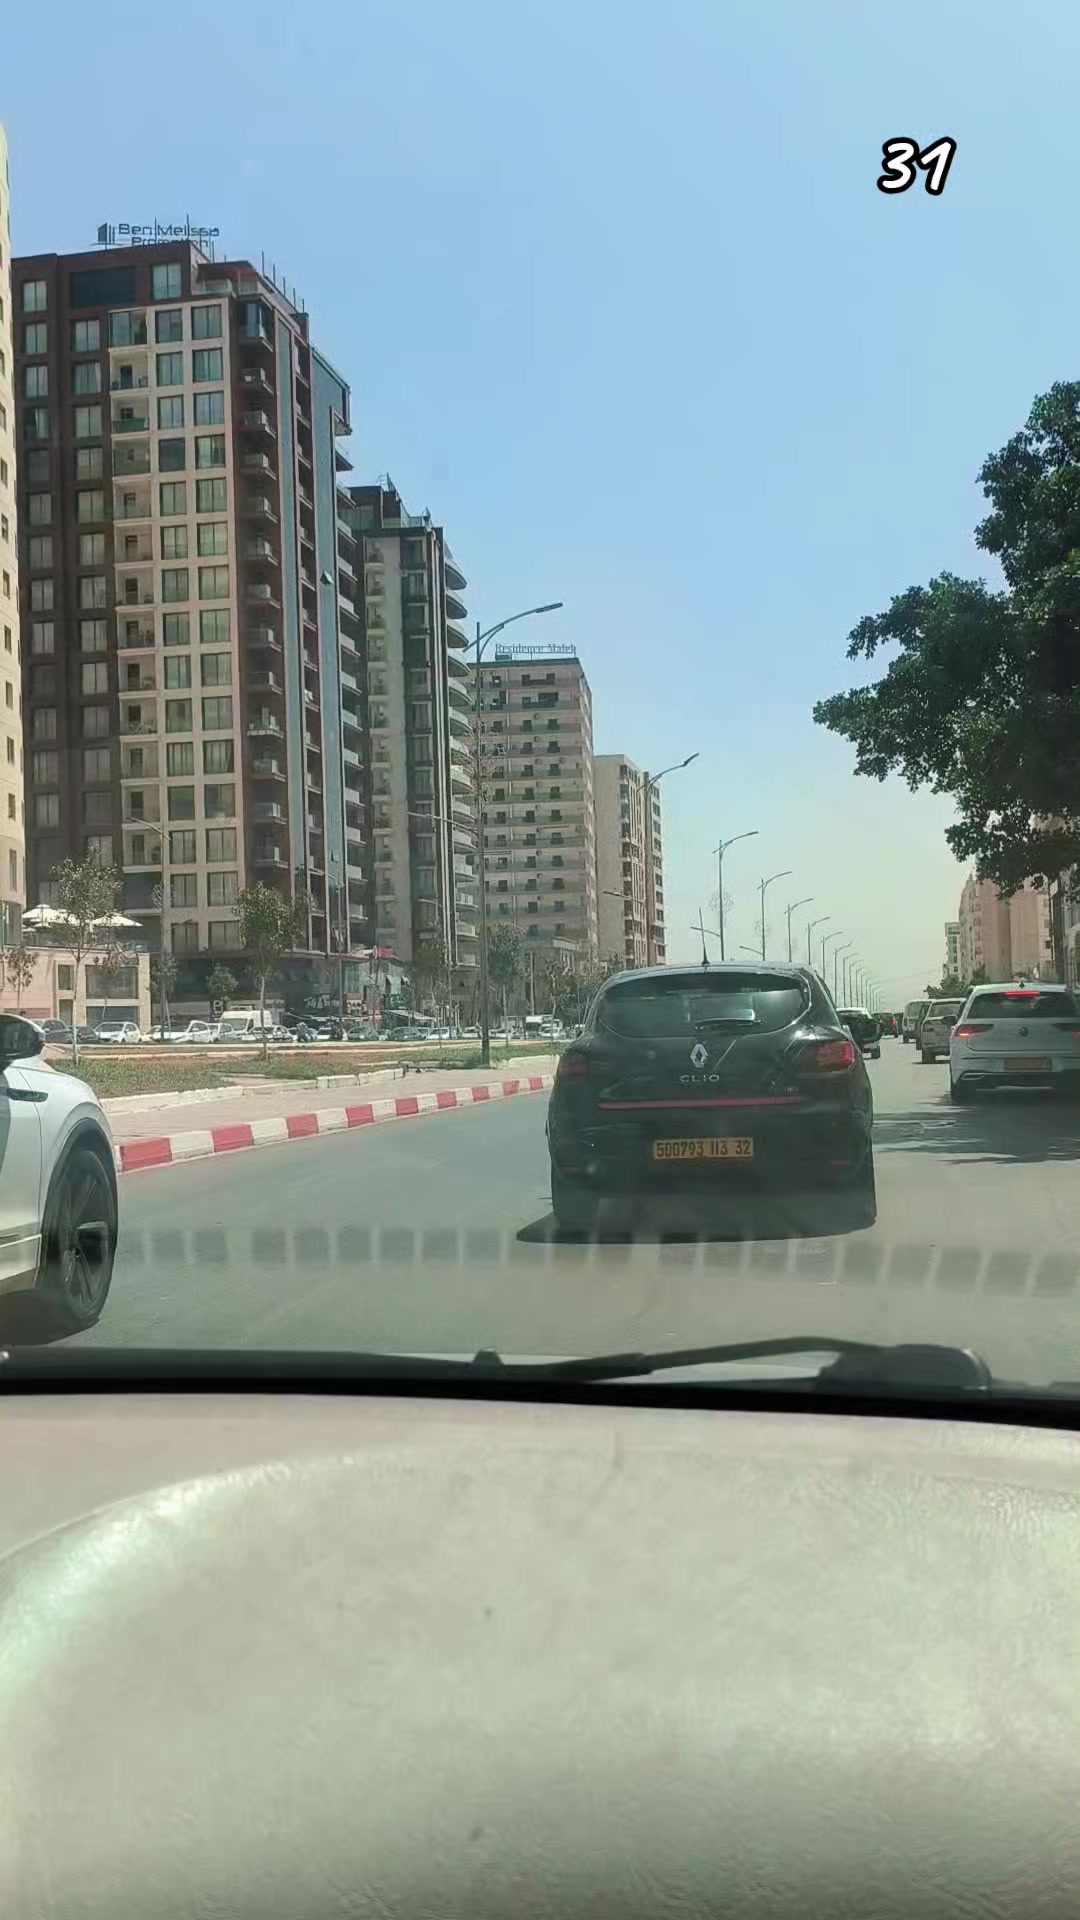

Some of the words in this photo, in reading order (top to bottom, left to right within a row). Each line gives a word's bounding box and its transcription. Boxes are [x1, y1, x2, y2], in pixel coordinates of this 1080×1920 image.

[118, 223, 153, 235] Ben
[680, 1073, 720, 1083] CLIO
[656, 1141, 704, 1158] 500793
[711, 1140, 728, 1156] 113
[735, 1139, 752, 1155] 32
